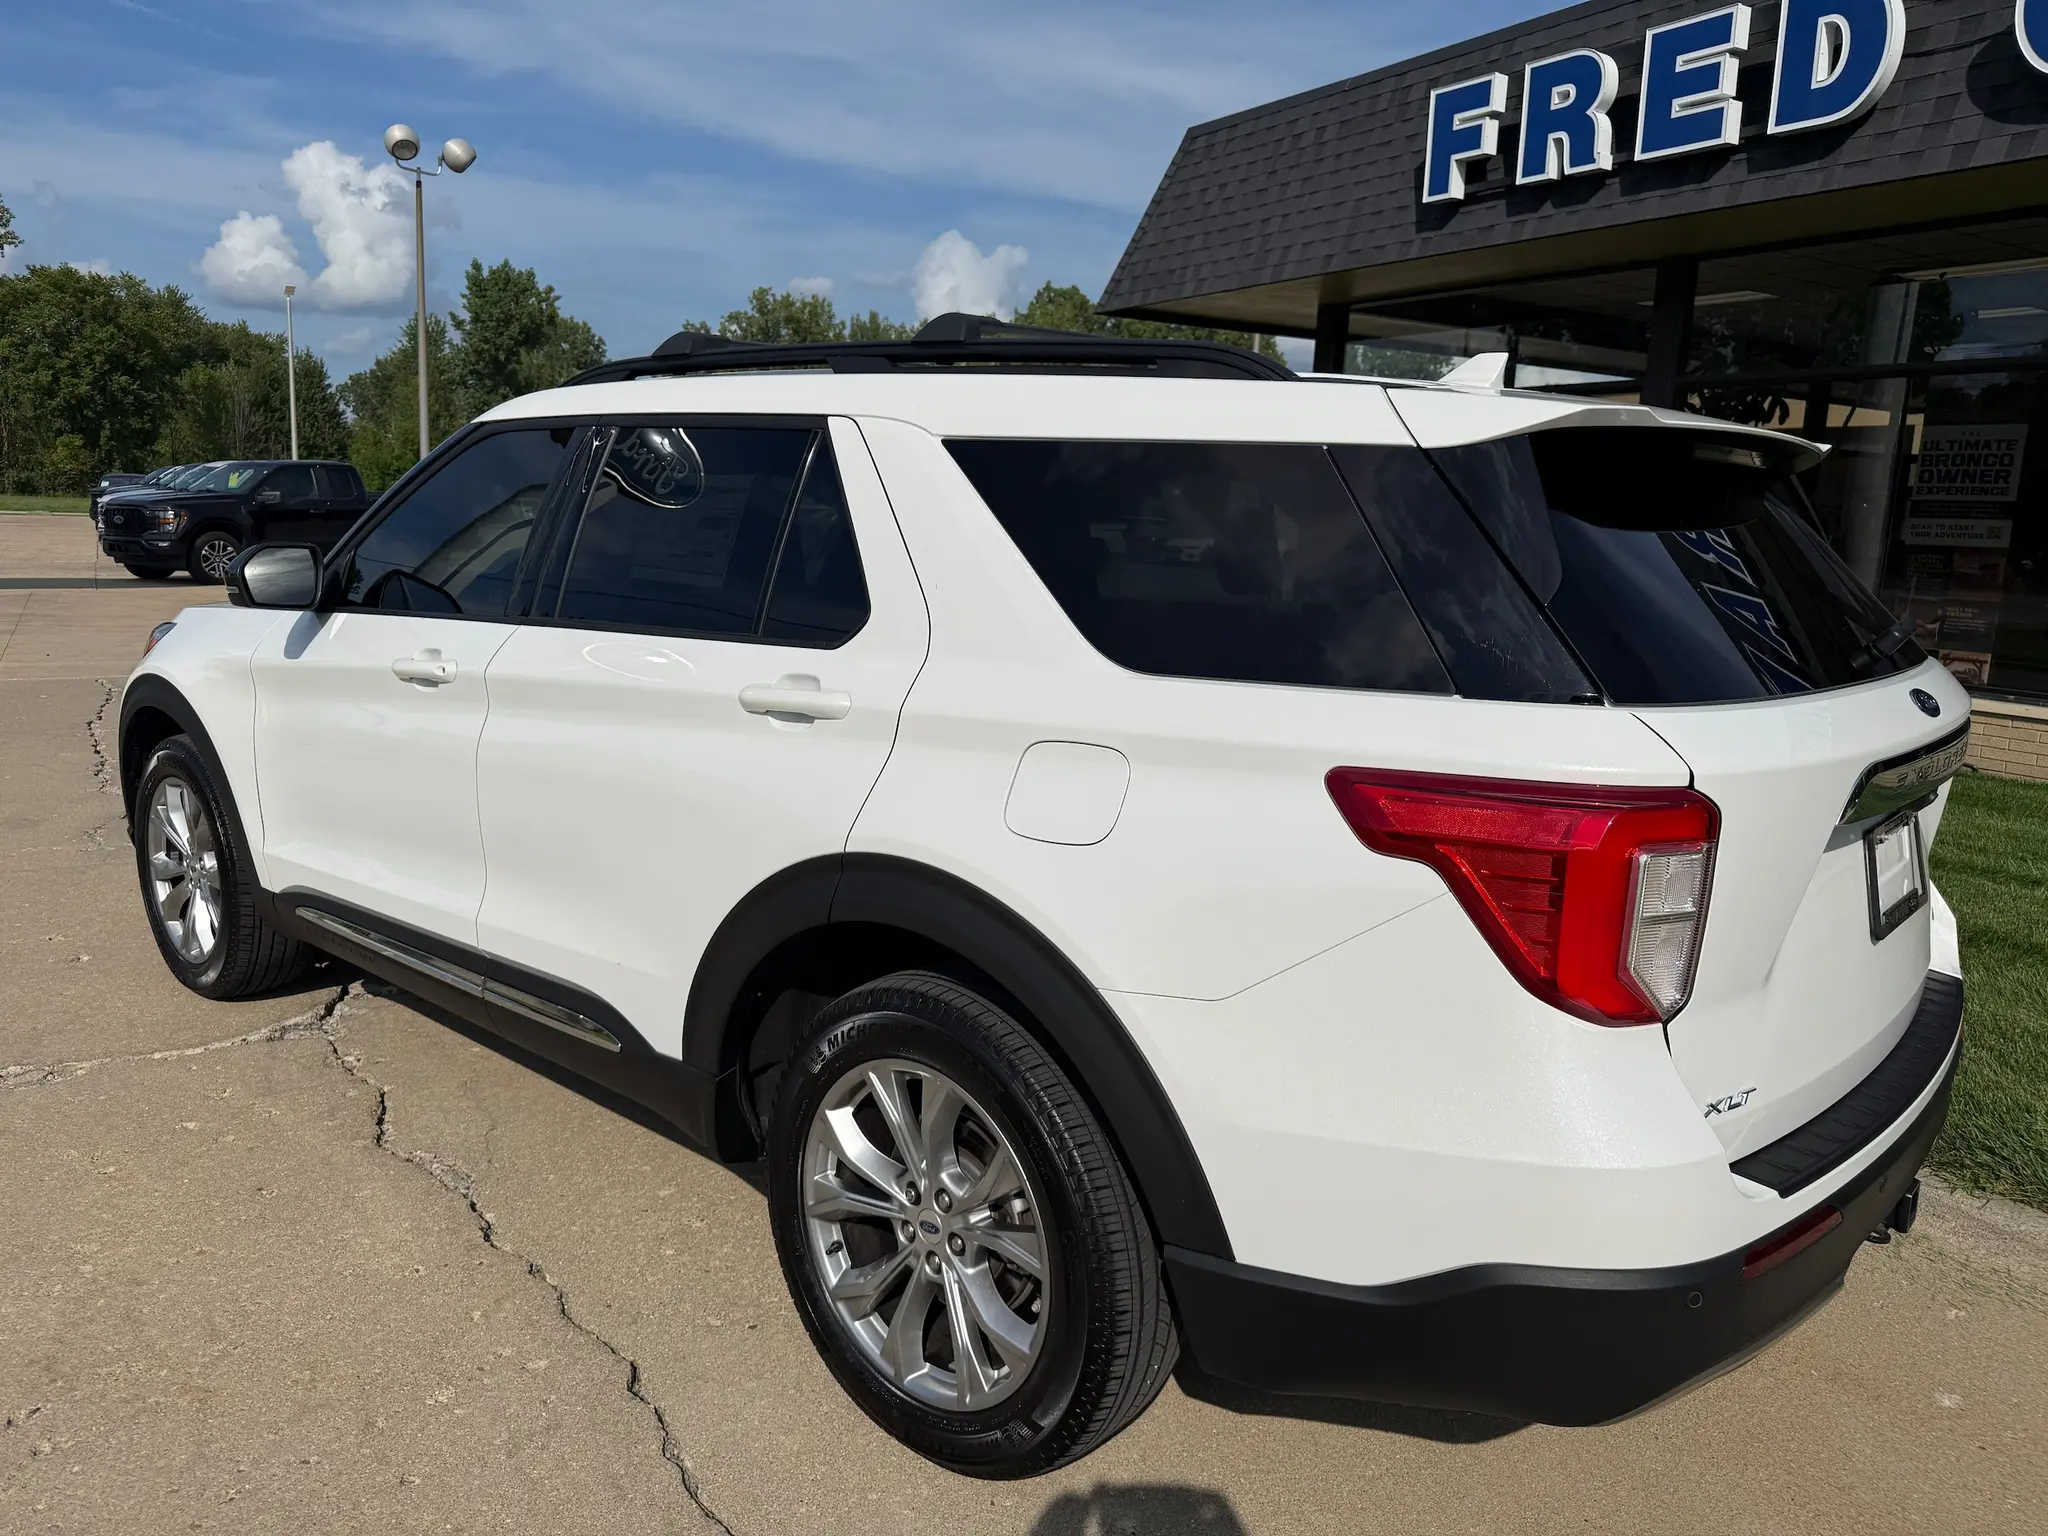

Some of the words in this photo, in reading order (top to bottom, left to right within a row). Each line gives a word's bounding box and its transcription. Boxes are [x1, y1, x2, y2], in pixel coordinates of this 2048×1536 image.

[1422, 0, 1906, 204] FRED
[1923, 439, 2019, 451] ULTIMATE
[1920, 453, 2015, 467] BRONCO
[1918, 469, 2012, 485] OWNER
[1915, 486, 2010, 496] EXPERIENCE
[1934, 531, 1985, 540] ADVENTURE
[827, 1022, 912, 1052] MICH
[1704, 1087, 1757, 1119] XLT
